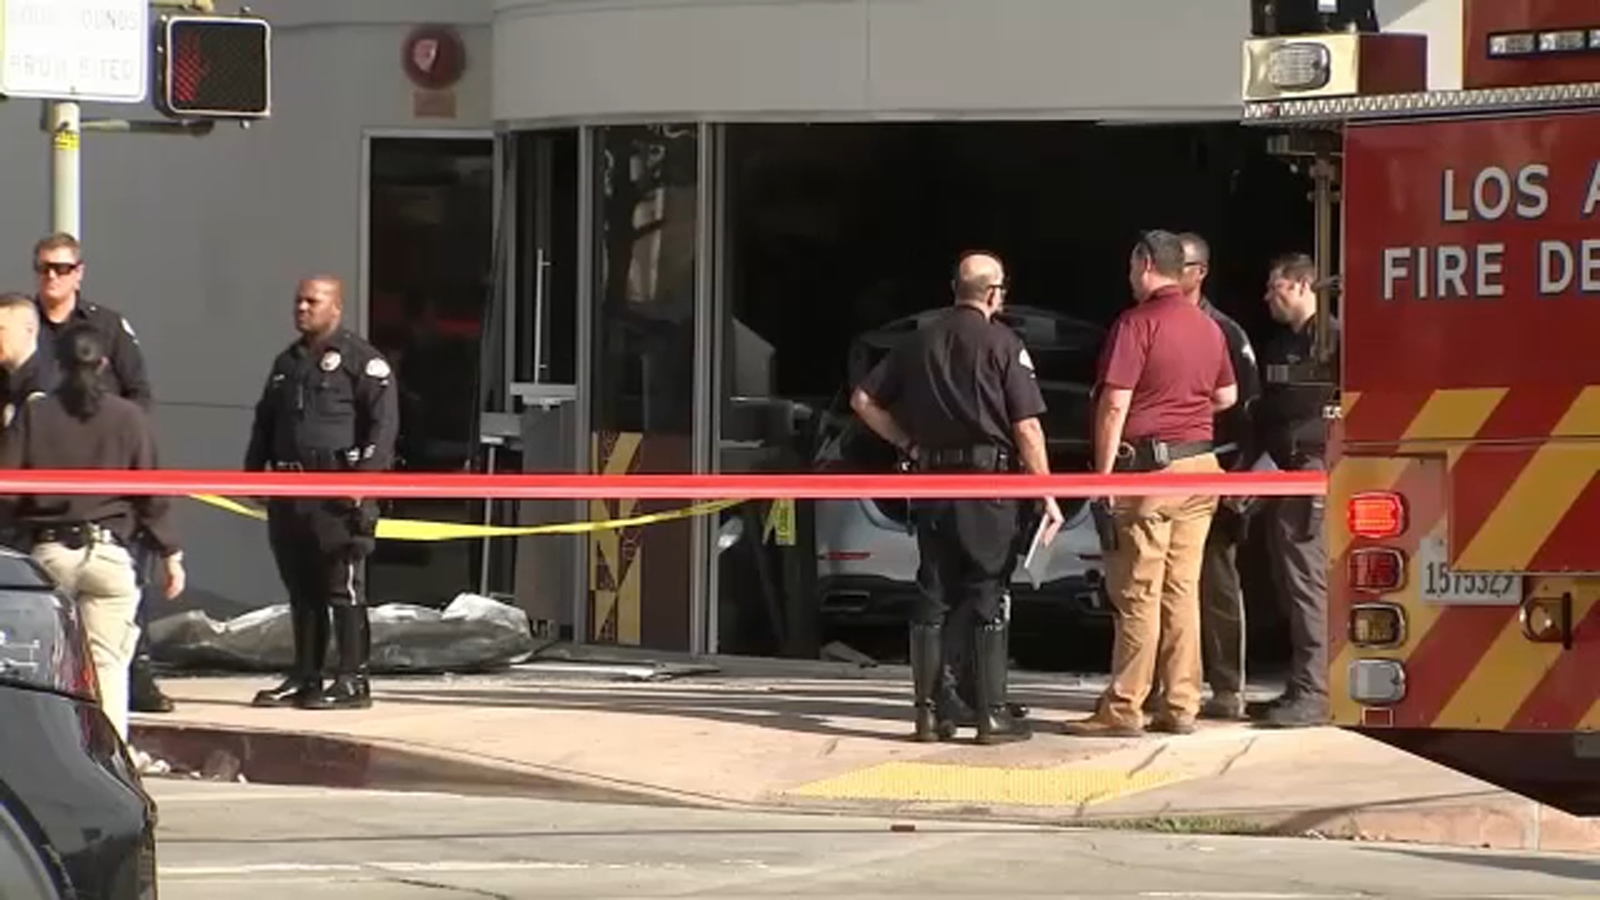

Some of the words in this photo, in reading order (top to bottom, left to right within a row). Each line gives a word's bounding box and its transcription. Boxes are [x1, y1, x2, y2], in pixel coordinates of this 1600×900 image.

[1443, 164, 1549, 221] LOS
[1383, 243, 1504, 299] FIRE
[1540, 239, 1600, 293] DE
